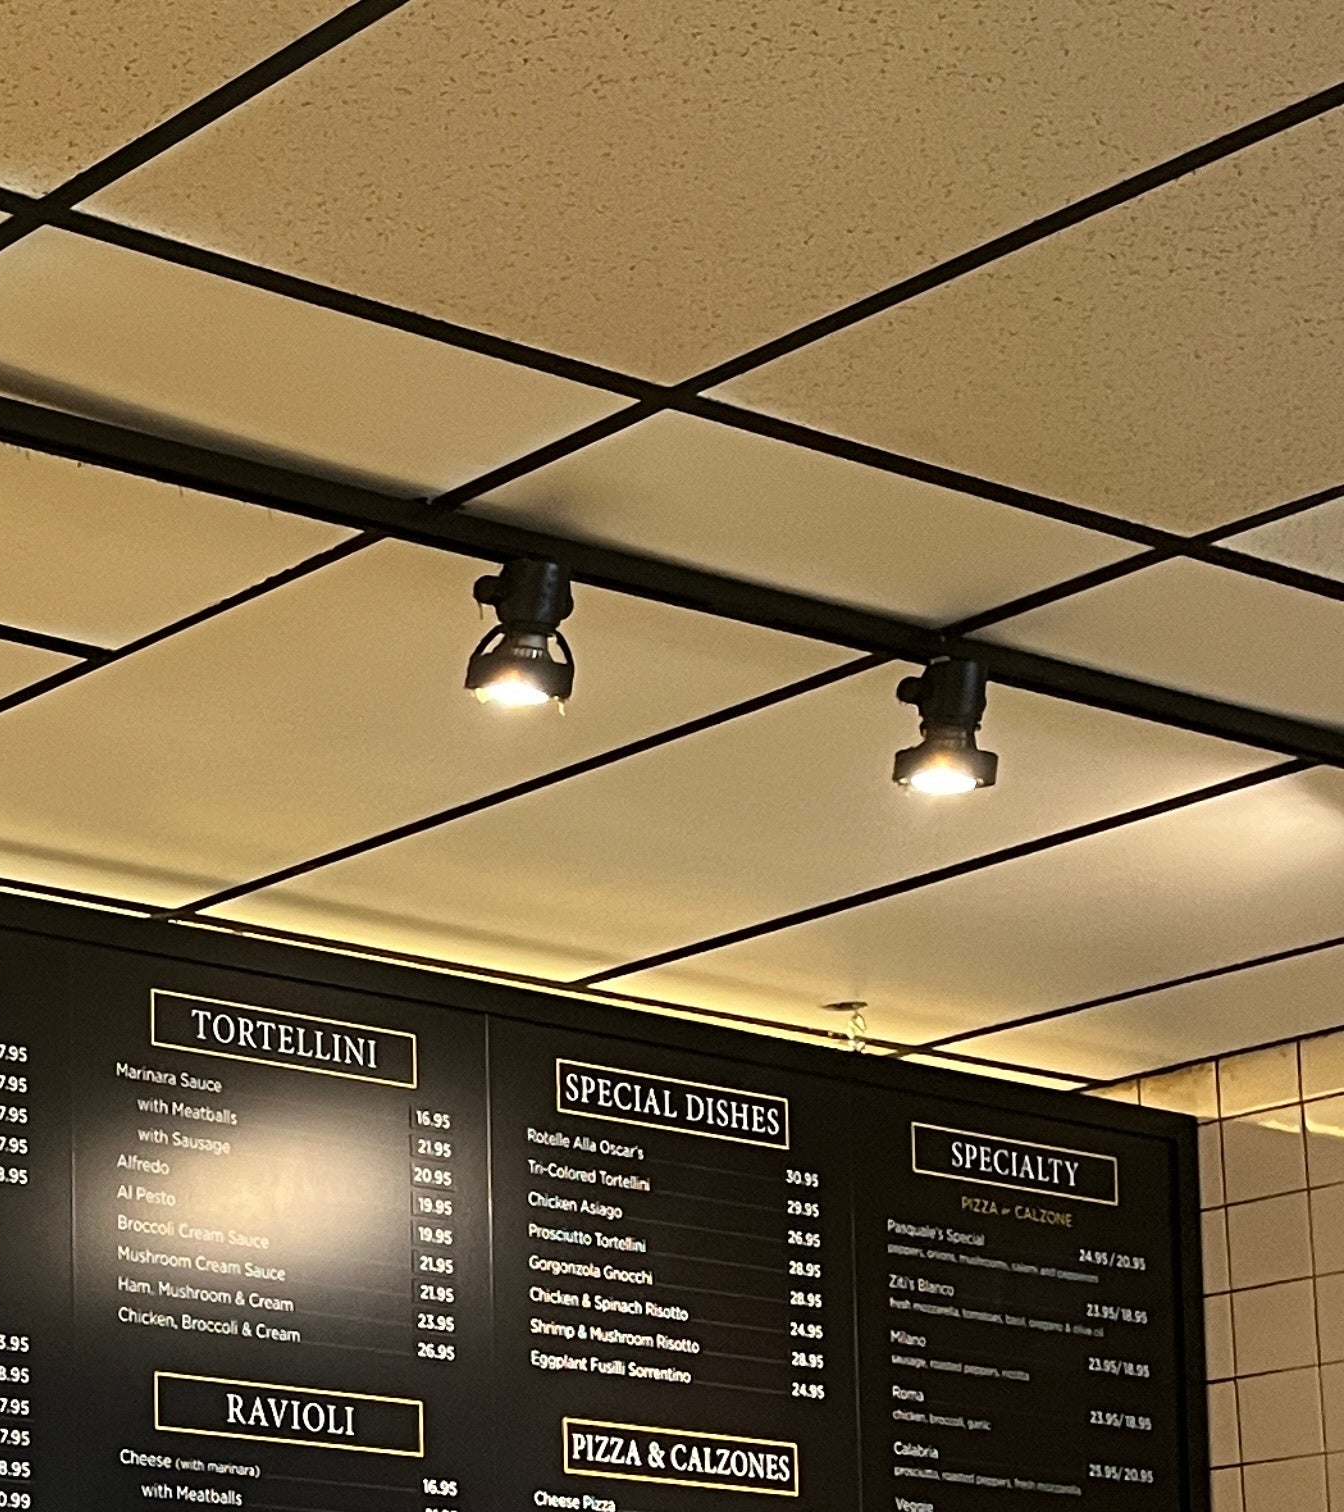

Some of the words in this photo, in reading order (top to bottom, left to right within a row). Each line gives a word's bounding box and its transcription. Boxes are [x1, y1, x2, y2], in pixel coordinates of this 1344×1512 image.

[192, 1010, 376, 1068] TORTELLINI
[116, 1062, 176, 1085] Marinara
[181, 1072, 222, 1092] Sauce
[417, 1110, 450, 1129] 16.95
[566, 1074, 677, 1118] SPECIAL
[686, 1094, 779, 1135] DISHES
[117, 1154, 169, 1174] Alfredo
[418, 1197, 452, 1215] 19.95
[952, 1142, 1078, 1186] SPECIALTY
[528, 1191, 577, 1211] Chicken
[580, 1200, 622, 1220] Asiago
[962, 1196, 998, 1214] PIZZA
[1015, 1206, 1072, 1228] CALZONE
[529, 1255, 601, 1278] Gorgonzola
[603, 1265, 652, 1285] Gnocchi
[227, 1394, 354, 1435] RAVIOLI
[572, 1433, 642, 1466] PIZZA
[648, 1441, 665, 1468] &
[670, 1444, 790, 1481] CALZONES
[534, 1490, 580, 1509] Cheese
[583, 1495, 615, 1512] Pizza
